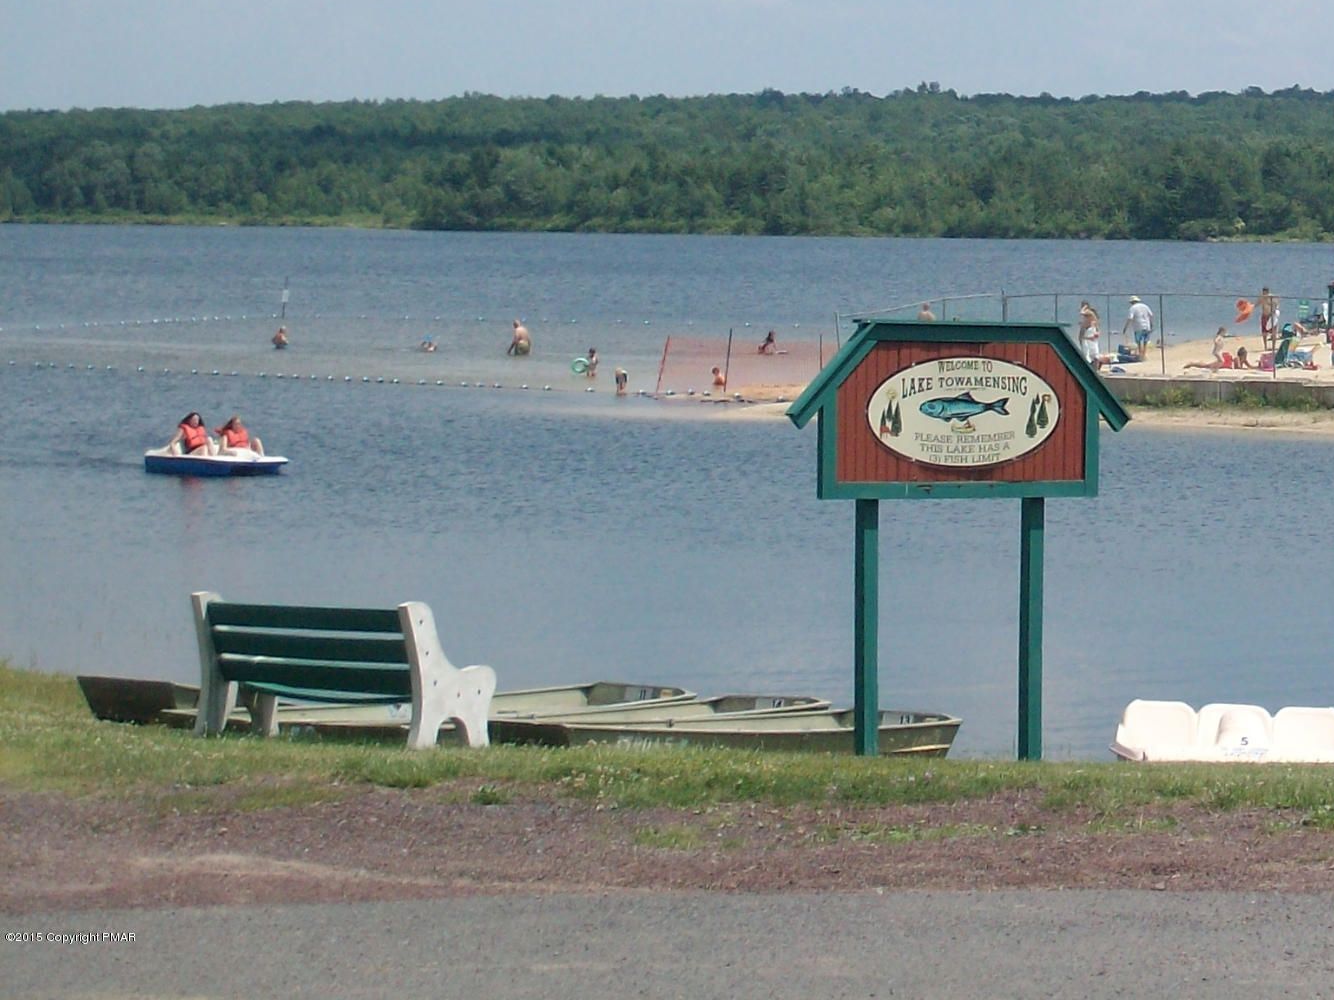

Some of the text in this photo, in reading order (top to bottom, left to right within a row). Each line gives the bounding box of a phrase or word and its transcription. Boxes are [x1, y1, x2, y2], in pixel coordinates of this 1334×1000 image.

[938, 361, 993, 373] WELCOME TO
[902, 376, 1028, 399] LAKE TOWAMENSING
[914, 431, 1015, 444] PLEASE REMEMBER
[920, 441, 1010, 453] THIS LAKE HAS A
[944, 455, 968, 464] FISH
[972, 453, 1000, 464] LIMIT
[1241, 736, 1249, 746] 5
